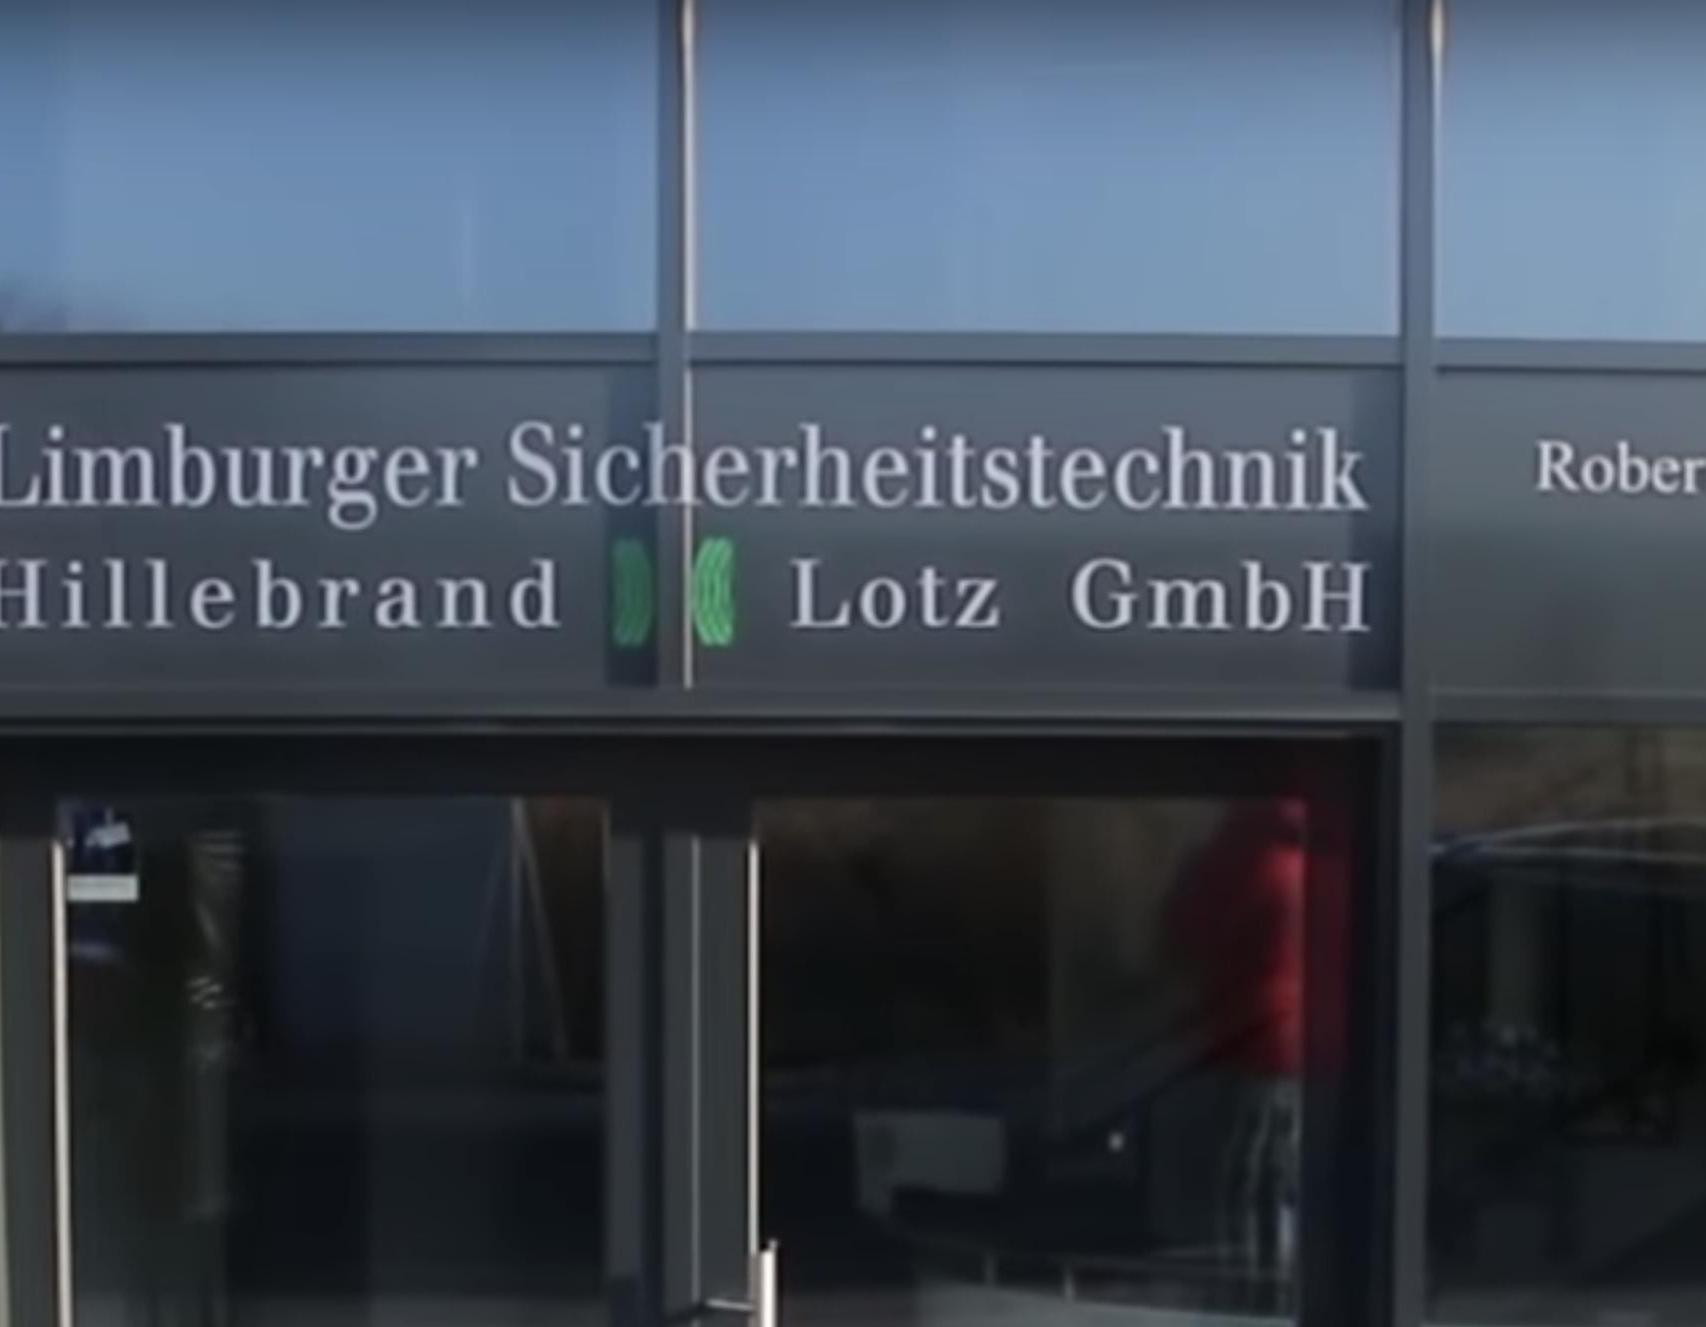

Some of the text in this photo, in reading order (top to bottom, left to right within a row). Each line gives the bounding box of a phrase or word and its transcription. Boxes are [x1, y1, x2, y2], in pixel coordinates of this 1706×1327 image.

[506, 420, 1370, 513] Sicherheitstechnik
[790, 557, 1000, 630] Lotz
[1071, 556, 1372, 633] GmbH
